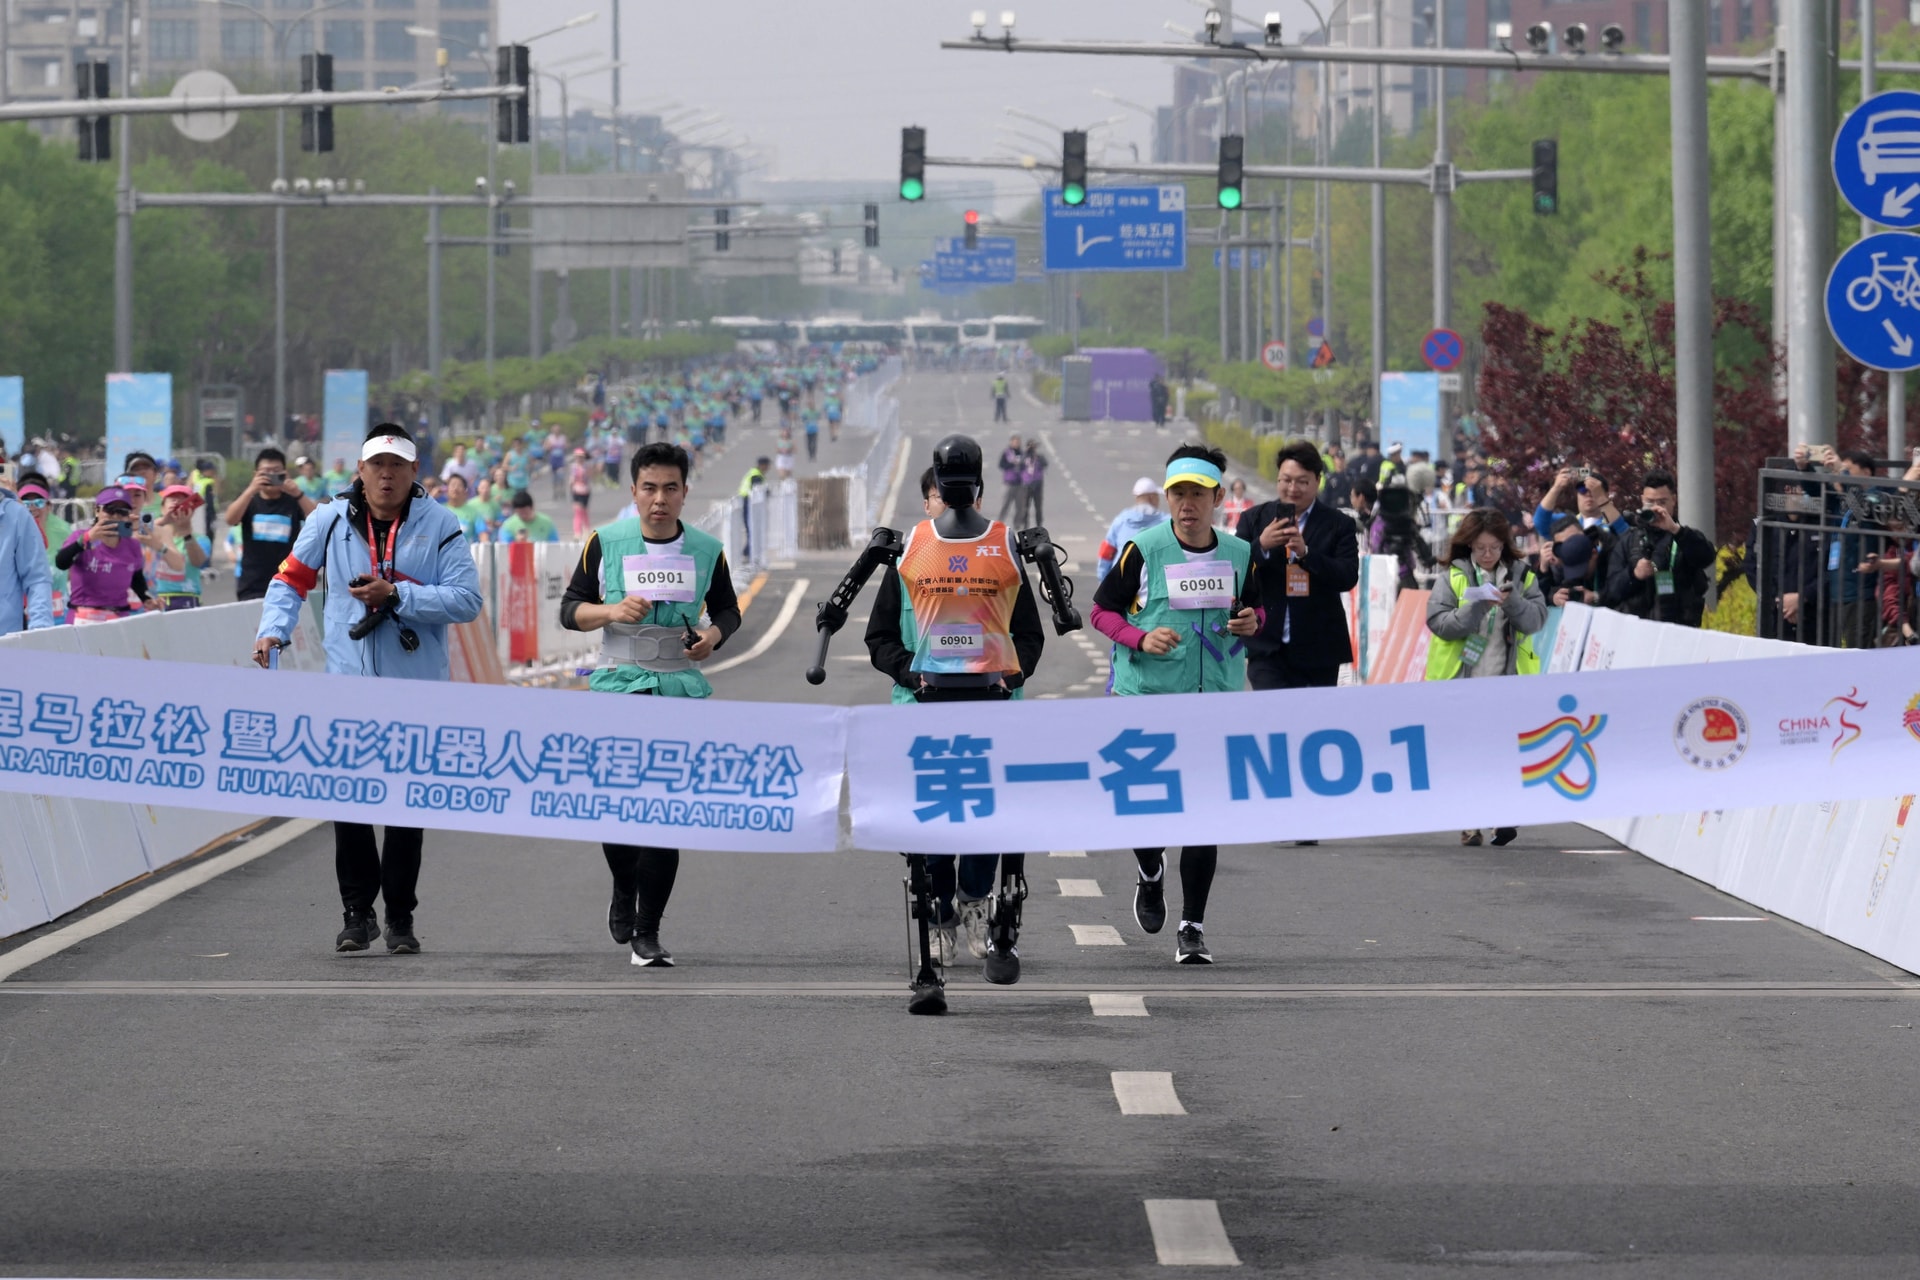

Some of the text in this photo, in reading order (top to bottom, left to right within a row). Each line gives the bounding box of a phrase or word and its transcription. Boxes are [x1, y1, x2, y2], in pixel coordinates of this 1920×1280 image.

[1269, 349, 1283, 360] 30
[976, 545, 1002, 557] 天工
[637, 572, 684, 584] 60901
[1180, 578, 1224, 592] 60901
[940, 635, 974, 646] 60901
[1779, 717, 1830, 732] CHINA
[221, 709, 803, 799] 暨人形机器人半程马拉松
[907, 724, 1432, 824] 第一名 NO.1
[136, 759, 205, 789] AND
[217, 766, 387, 804] HUMANOID
[406, 781, 510, 814] ROBOT
[531, 790, 794, 832] HALF-MARATHON
